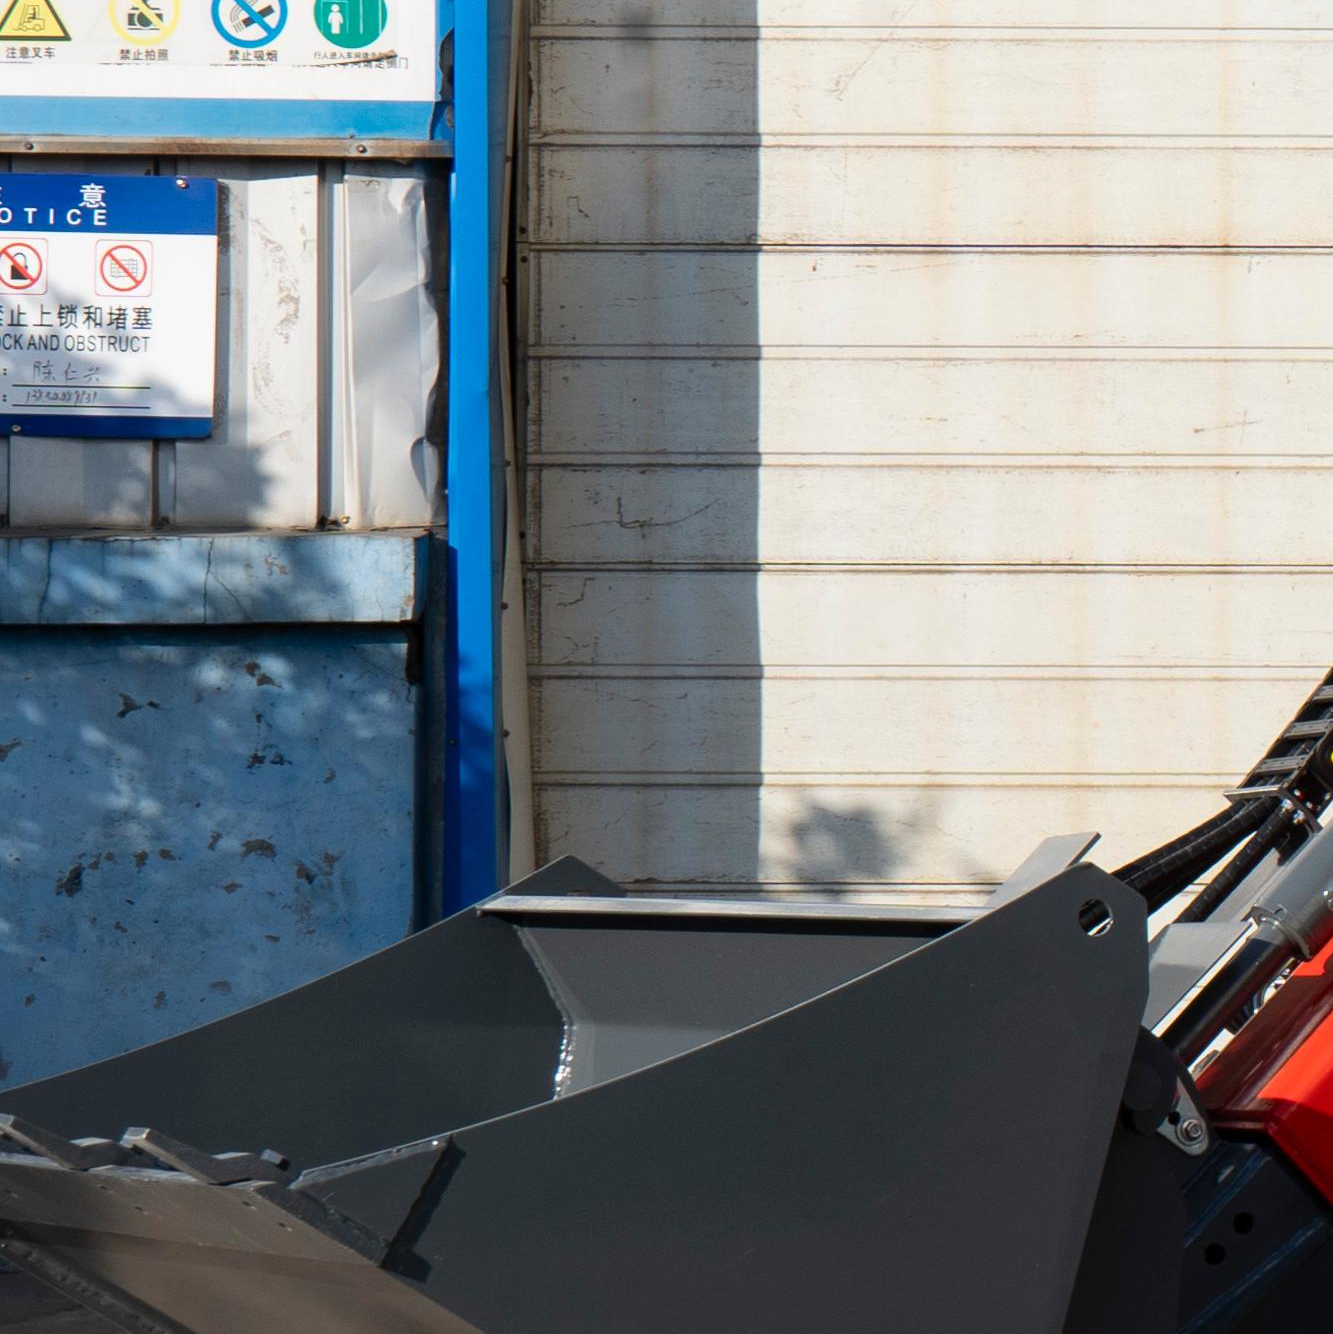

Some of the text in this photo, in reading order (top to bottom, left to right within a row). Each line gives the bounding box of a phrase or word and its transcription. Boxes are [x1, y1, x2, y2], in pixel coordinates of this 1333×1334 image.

[6, 46, 56, 59] 注意叉车
[119, 48, 170, 61] 禁止拍照
[229, 49, 279, 62] 禁止吸烟
[78, 182, 107, 208] 意
[0, 303, 152, 330] 止上锁和堵塞
[0, 333, 151, 352] CK AND OBSTRUCT
